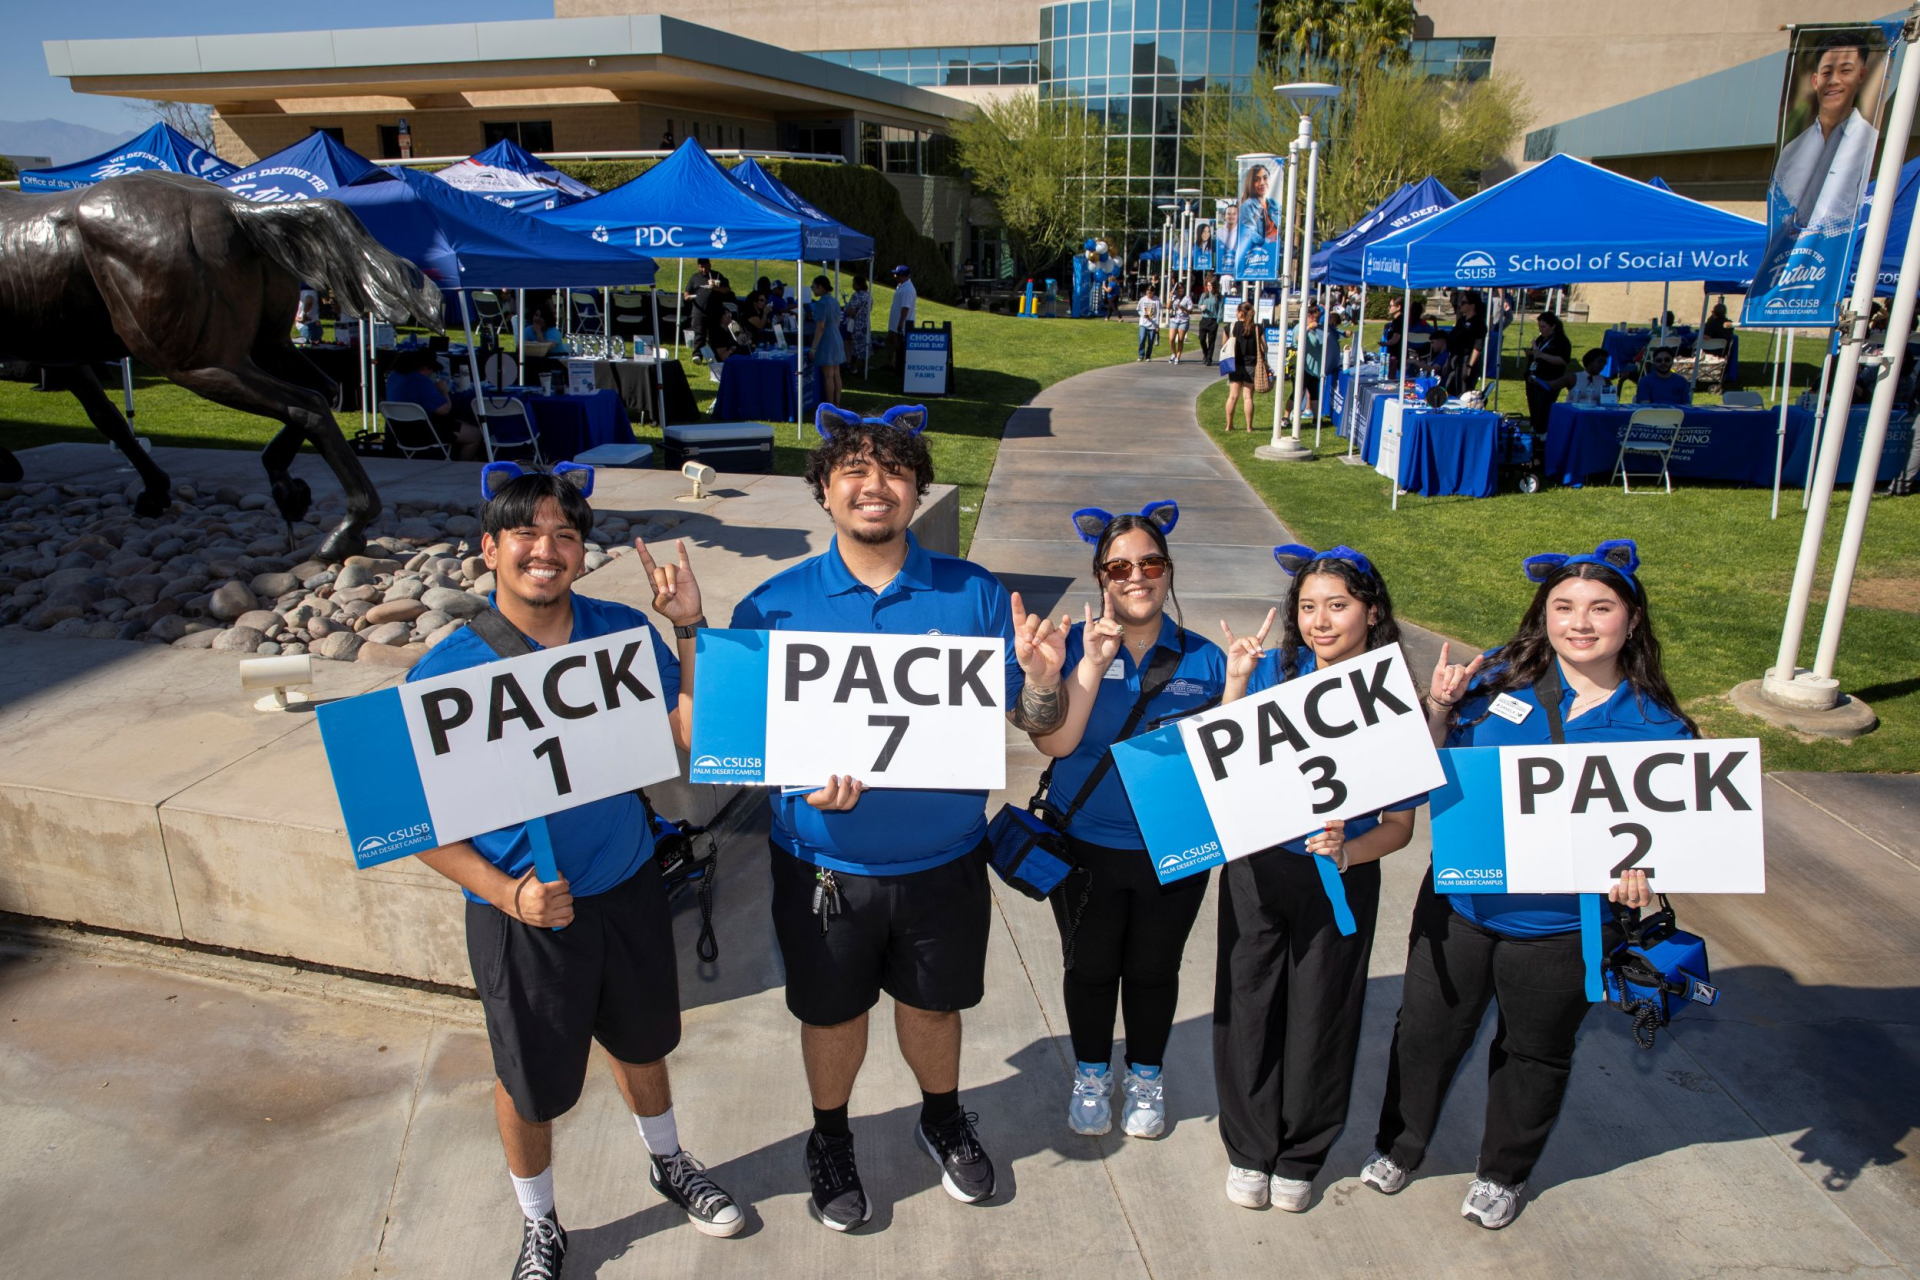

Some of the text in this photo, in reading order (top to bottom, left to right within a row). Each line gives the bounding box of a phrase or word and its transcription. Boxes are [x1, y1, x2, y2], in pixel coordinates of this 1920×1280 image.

[109, 151, 172, 172] WE DEFINE TH
[22, 176, 46, 186] Office
[47, 178, 56, 187] of
[57, 180, 70, 188] the
[231, 172, 256, 184] WE
[258, 167, 311, 179] DEFINE
[307, 174, 329, 193] THE
[1390, 215, 1410, 228] WE
[635, 226, 684, 247] PDC
[1508, 249, 1749, 272] School of Social Work
[1773, 247, 1825, 264] WE DEFINE THE
[1455, 267, 1496, 280] CSUSB
[1768, 262, 1826, 288] Future
[1788, 298, 1820, 308] CSUSB
[910, 333, 946, 342] CHOOSE
[907, 364, 945, 372] RESOURCE
[784, 643, 997, 707] PACK
[420, 640, 656, 756] PACK
[1197, 656, 1413, 782] PACK
[867, 714, 910, 773] 7
[532, 736, 572, 796] 1
[723, 757, 762, 768] CSUSB
[1298, 755, 1348, 815] 3
[1517, 751, 1753, 815] PACK
[387, 822, 431, 843] CSUSB
[358, 833, 432, 860] PALM DESERT CAMPUS
[1182, 841, 1219, 860] CSUSB
[1609, 822, 1655, 880] 2
[1160, 850, 1221, 876] PALM DESERT CAMPUS
[1465, 869, 1504, 879] CSUSB
